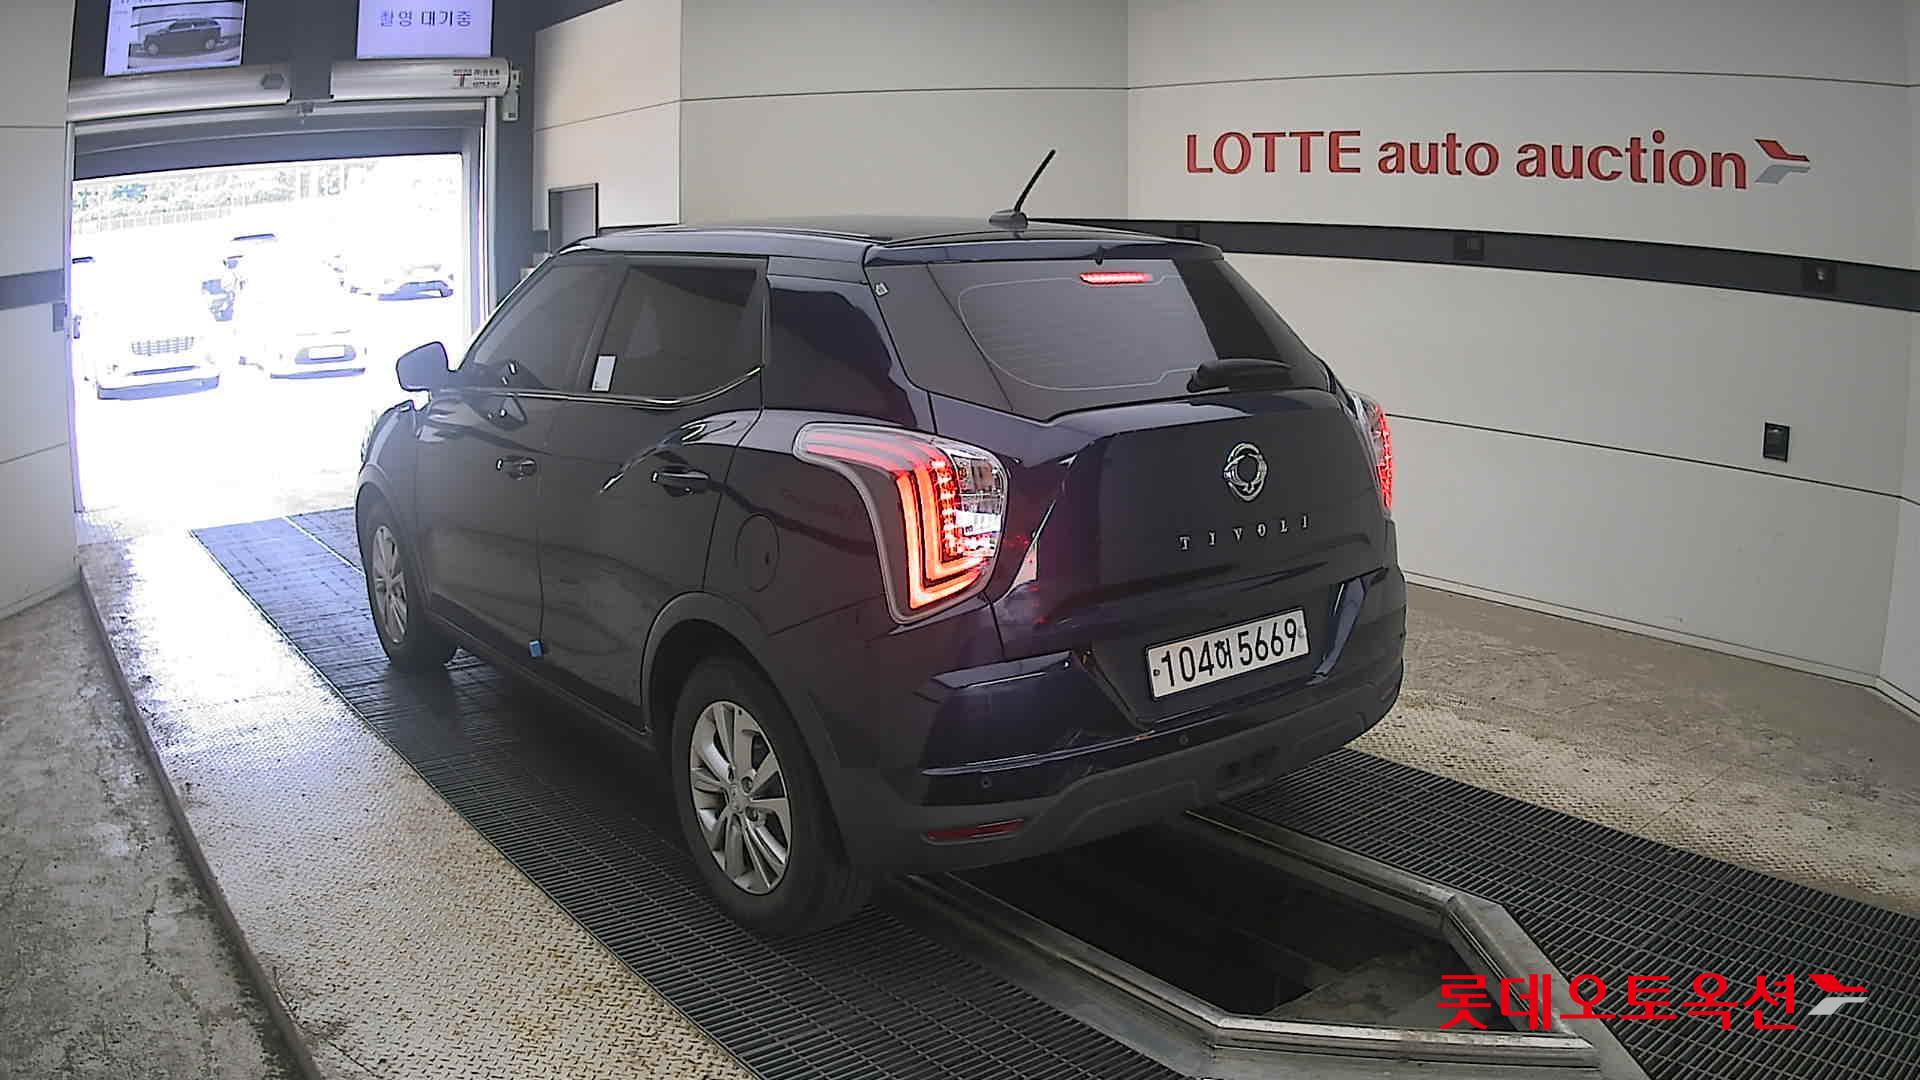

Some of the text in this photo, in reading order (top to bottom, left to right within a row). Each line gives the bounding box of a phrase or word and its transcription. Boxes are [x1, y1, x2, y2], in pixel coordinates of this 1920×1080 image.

[421, 10, 472, 27] 대기중
[1186, 130, 1747, 189] LOTTE auto auction
[1178, 514, 1310, 551] TIVOLI
